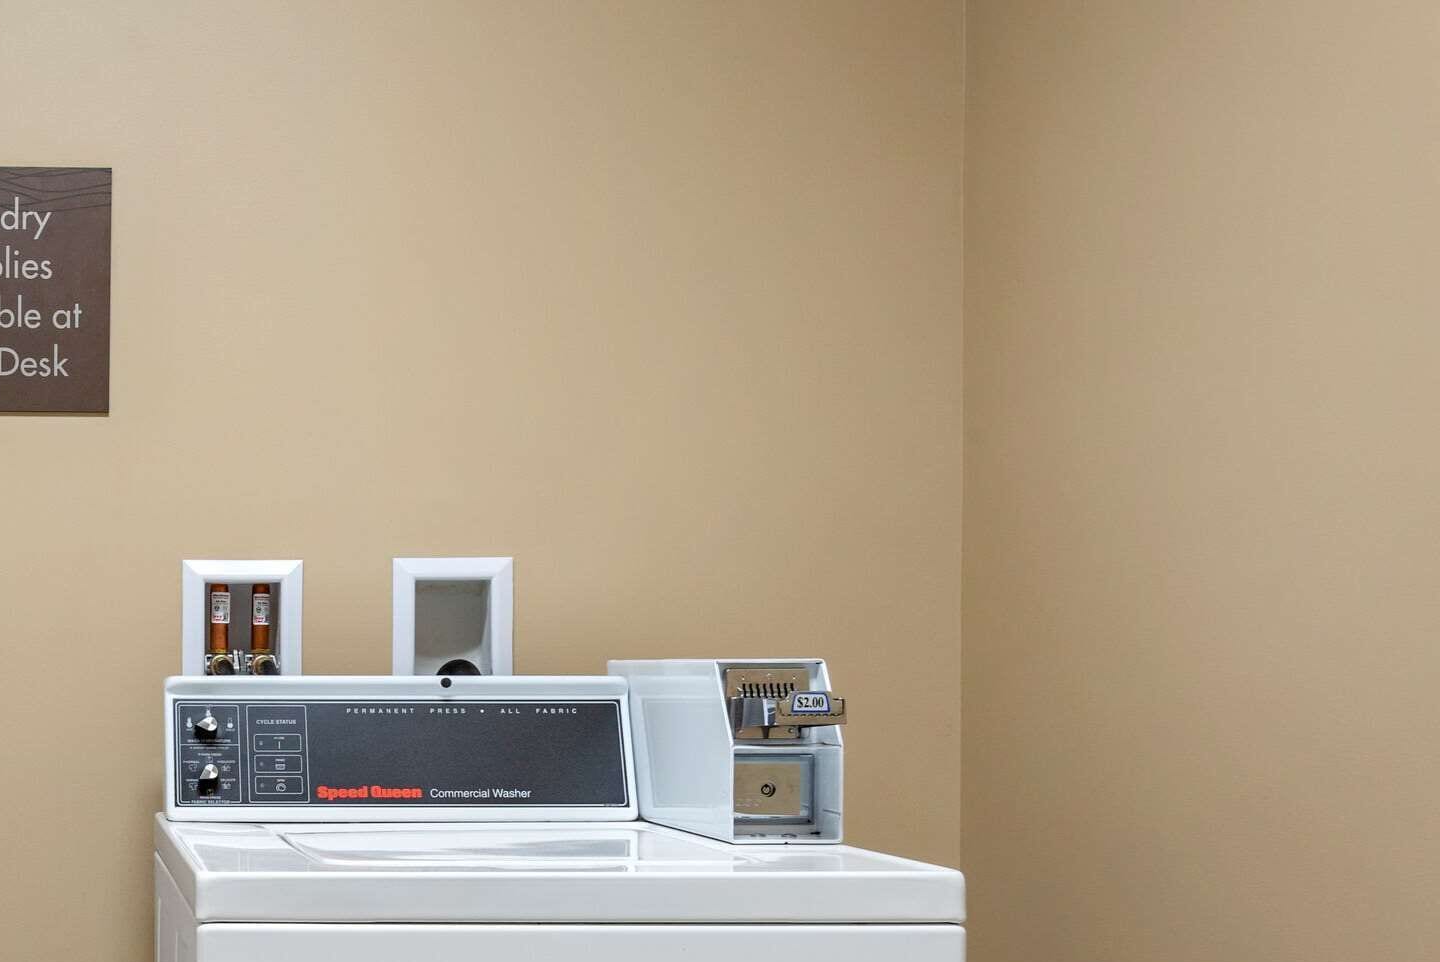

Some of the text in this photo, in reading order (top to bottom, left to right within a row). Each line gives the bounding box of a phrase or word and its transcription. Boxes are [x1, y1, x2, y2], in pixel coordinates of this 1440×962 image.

[52, 303, 83, 329] at
[797, 696, 824, 708] $2.00
[316, 785, 532, 801] Speed Queen Commercial Washer
